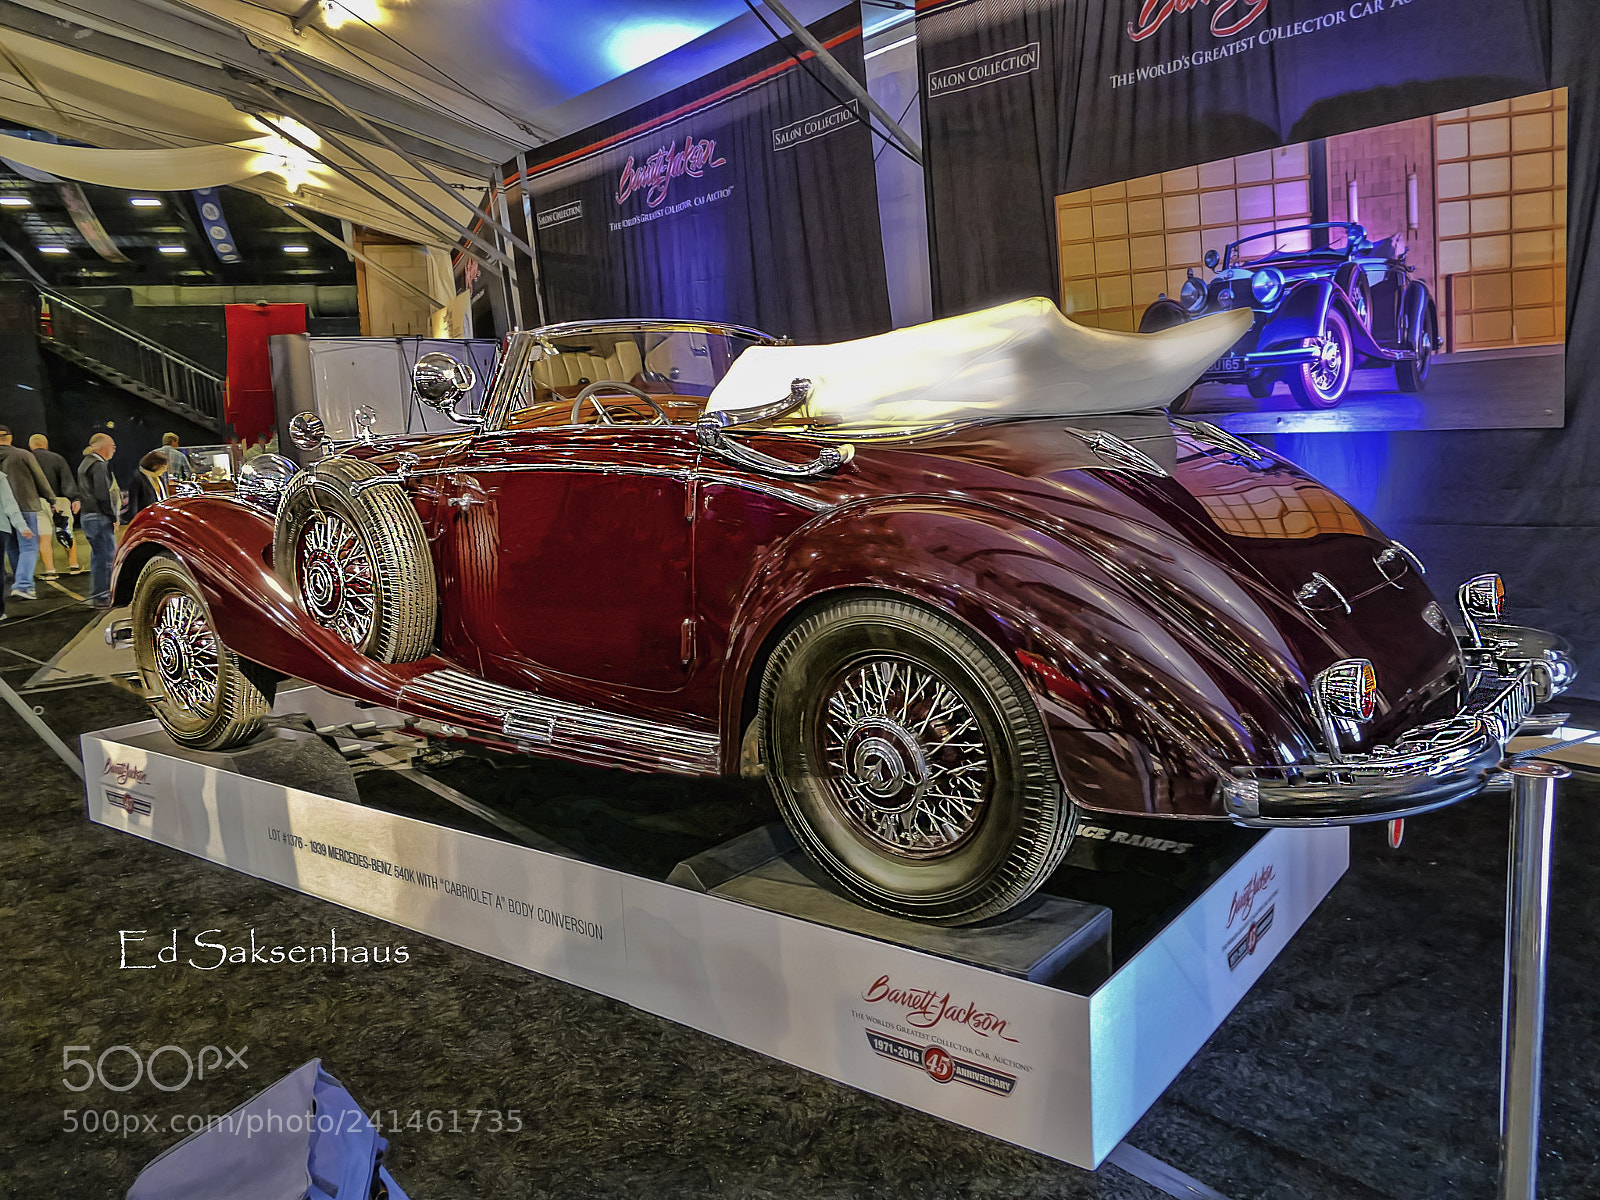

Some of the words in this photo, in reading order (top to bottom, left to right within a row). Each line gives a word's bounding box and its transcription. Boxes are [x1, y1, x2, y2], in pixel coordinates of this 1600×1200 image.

[1110, 74, 1135, 89] THE
[1136, 54, 1190, 82] WORLD'S
[1191, 35, 1256, 66] GREATEST
[1258, 10, 1347, 45] COLLECTOR
[1349, 0, 1385, 19] CAR
[931, 71, 966, 91] SALON
[968, 50, 1036, 81] COLLECTION
[775, 126, 802, 145] SALON
[608, 222, 622, 232] THE
[1110, 830, 1195, 854] RAMPS
[267, 827, 281, 843] LOT
[282, 834, 304, 849] #1376
[309, 840, 327, 857] 1939
[327, 844, 393, 877] MERCEDES-BENZ
[393, 865, 416, 884] 540K
[416, 871, 439, 891] WITH
[508, 898, 534, 920] BODY
[537, 907, 604, 941] CONVERSION
[851, 1009, 865, 1020] THE
[865, 1014, 895, 1030] WORLD'S
[896, 1024, 930, 1041] GREATEST
[931, 1035, 974, 1054] COLLECTOR
[974, 1048, 991, 1060] CAR
[860, 974, 1021, 1044] Barrett-Jackson
[873, 1038, 920, 1063] 1971-2016
[925, 1053, 951, 1077] 45
[956, 1065, 1011, 1091] ANNIVERSARY
